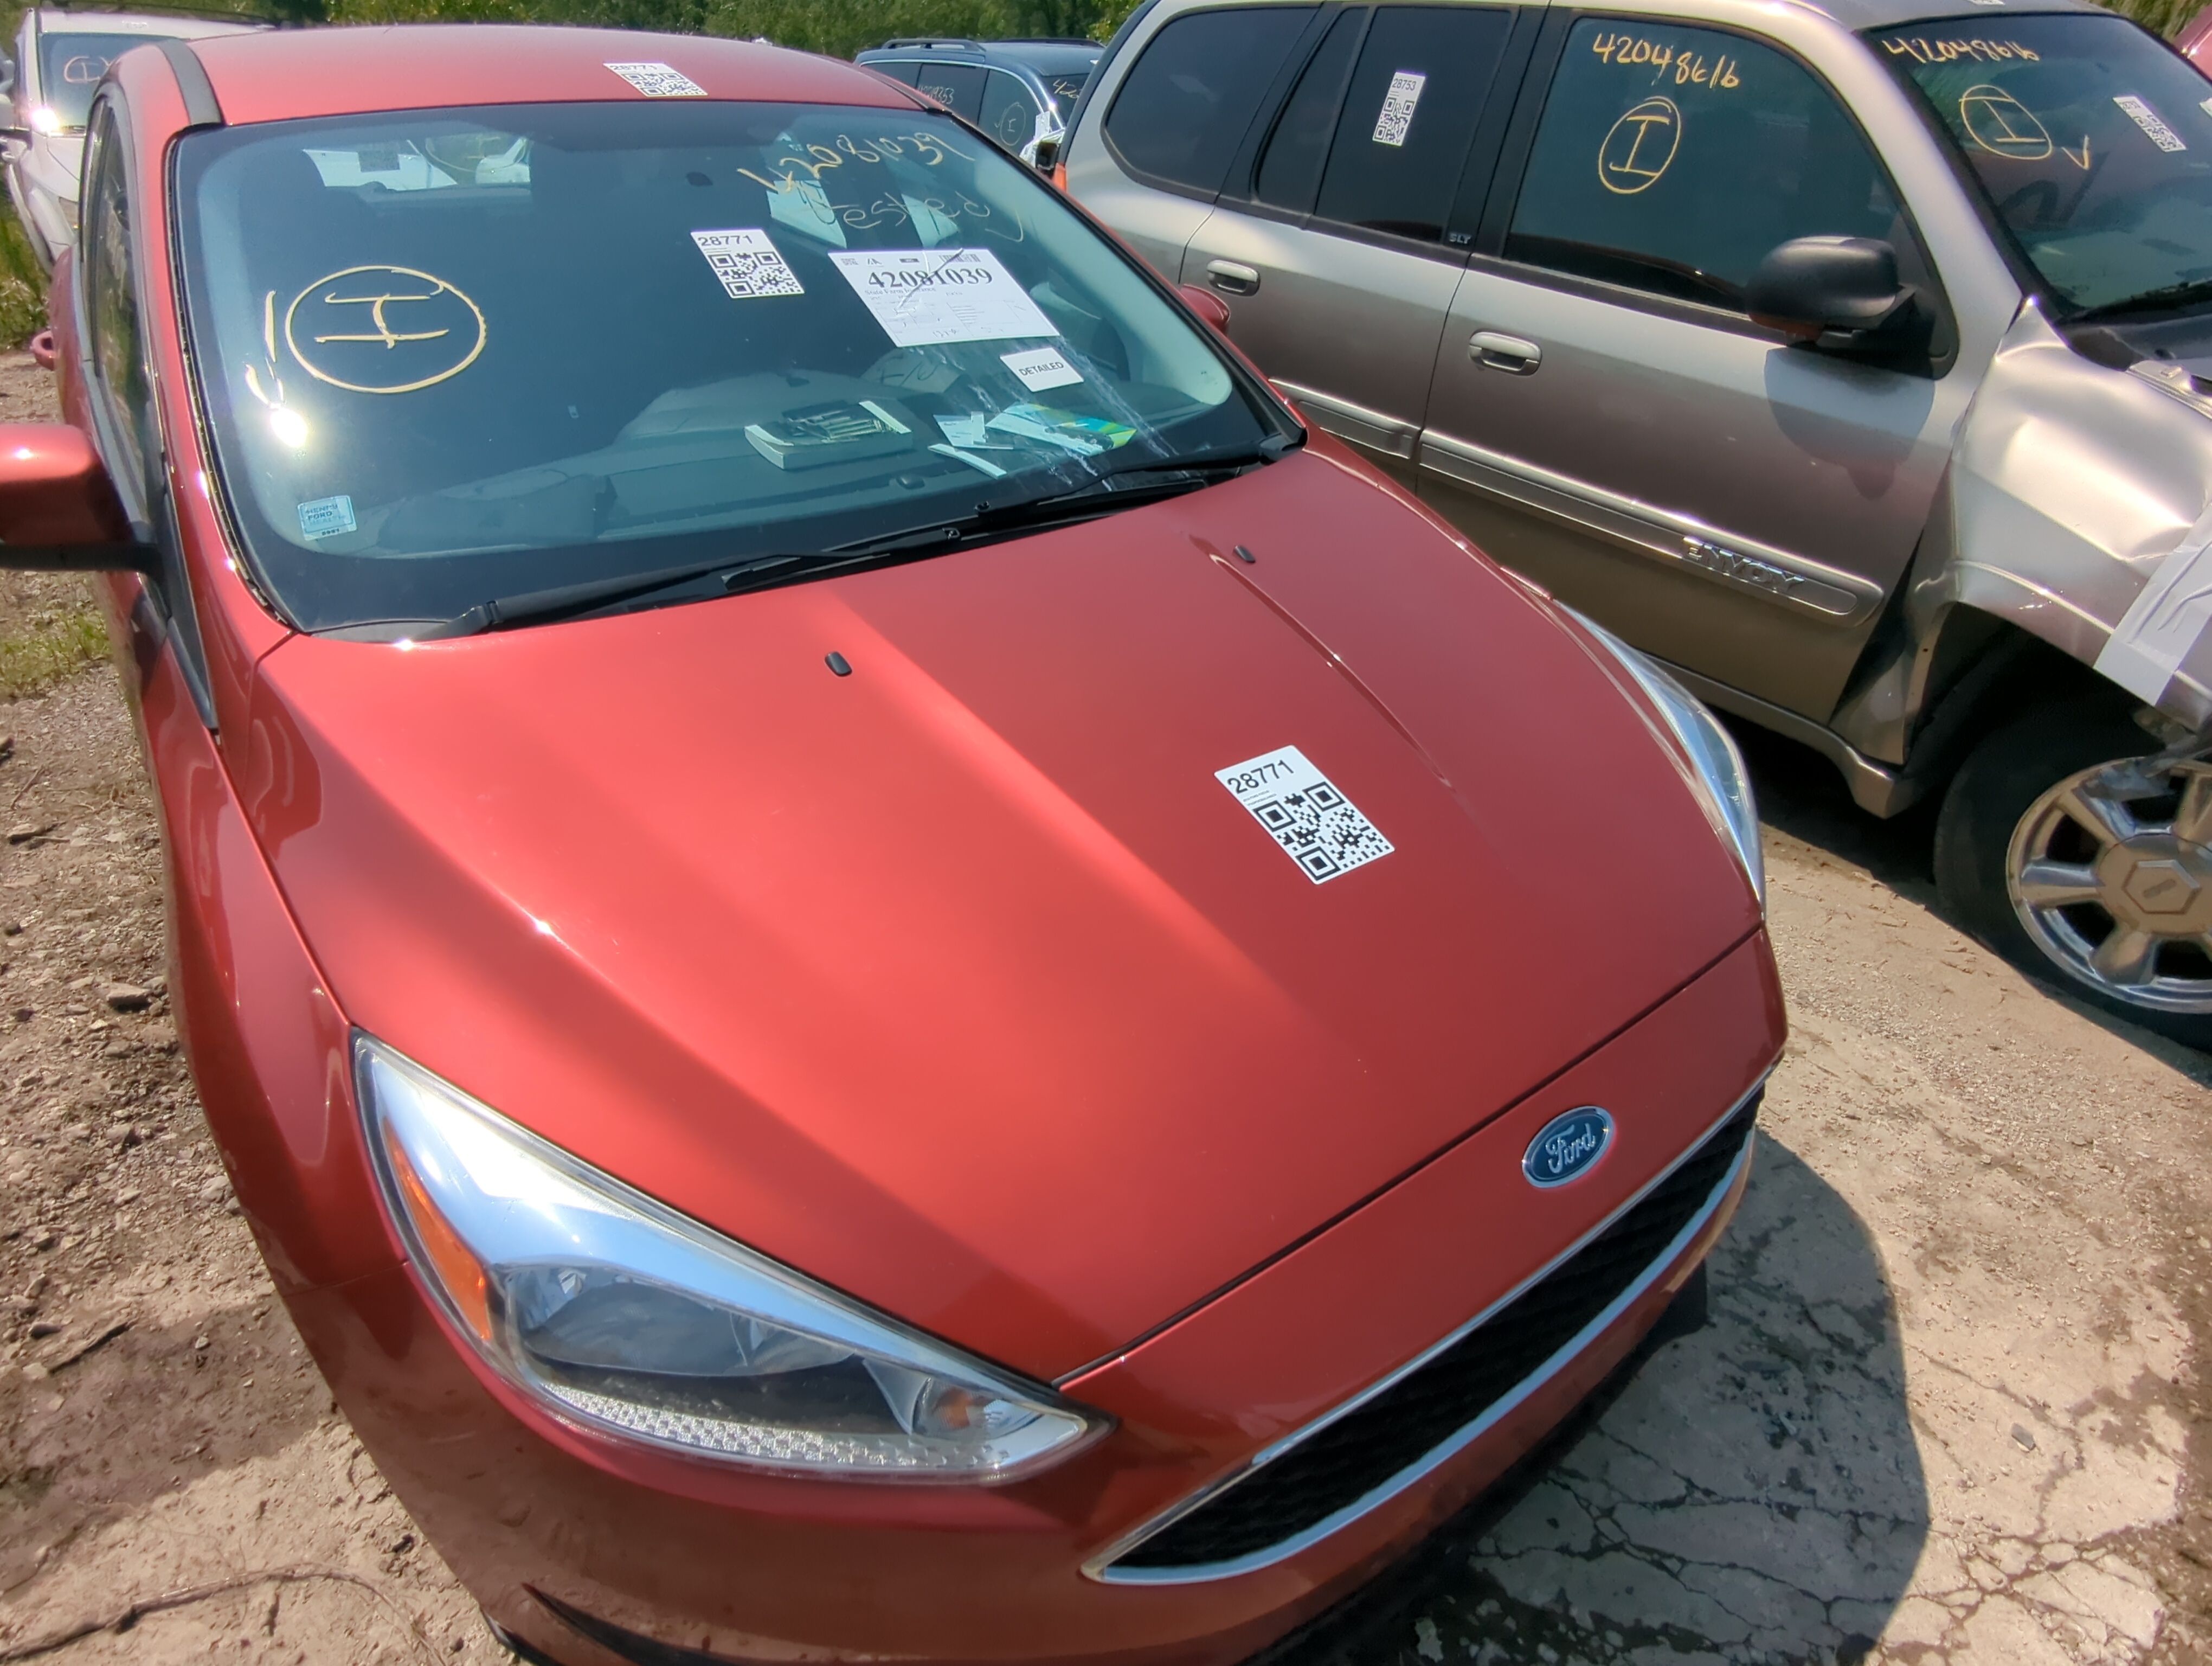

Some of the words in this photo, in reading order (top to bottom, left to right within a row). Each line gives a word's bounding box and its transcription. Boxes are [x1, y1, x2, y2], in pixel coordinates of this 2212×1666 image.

[1593, 33, 1740, 88] 42048616
[1392, 78, 1417, 91] 28753
[1609, 115, 1670, 176] I
[698, 235, 753, 247] 28771
[1449, 232, 1471, 244] SLT
[869, 267, 993, 289] 42081039
[1019, 362, 1064, 376] DETAILED
[308, 511, 333, 521] FORD
[1683, 536, 1805, 593] ENVOY
[1227, 759, 1294, 794] 28771
[1546, 1123, 1596, 1174] Ford
